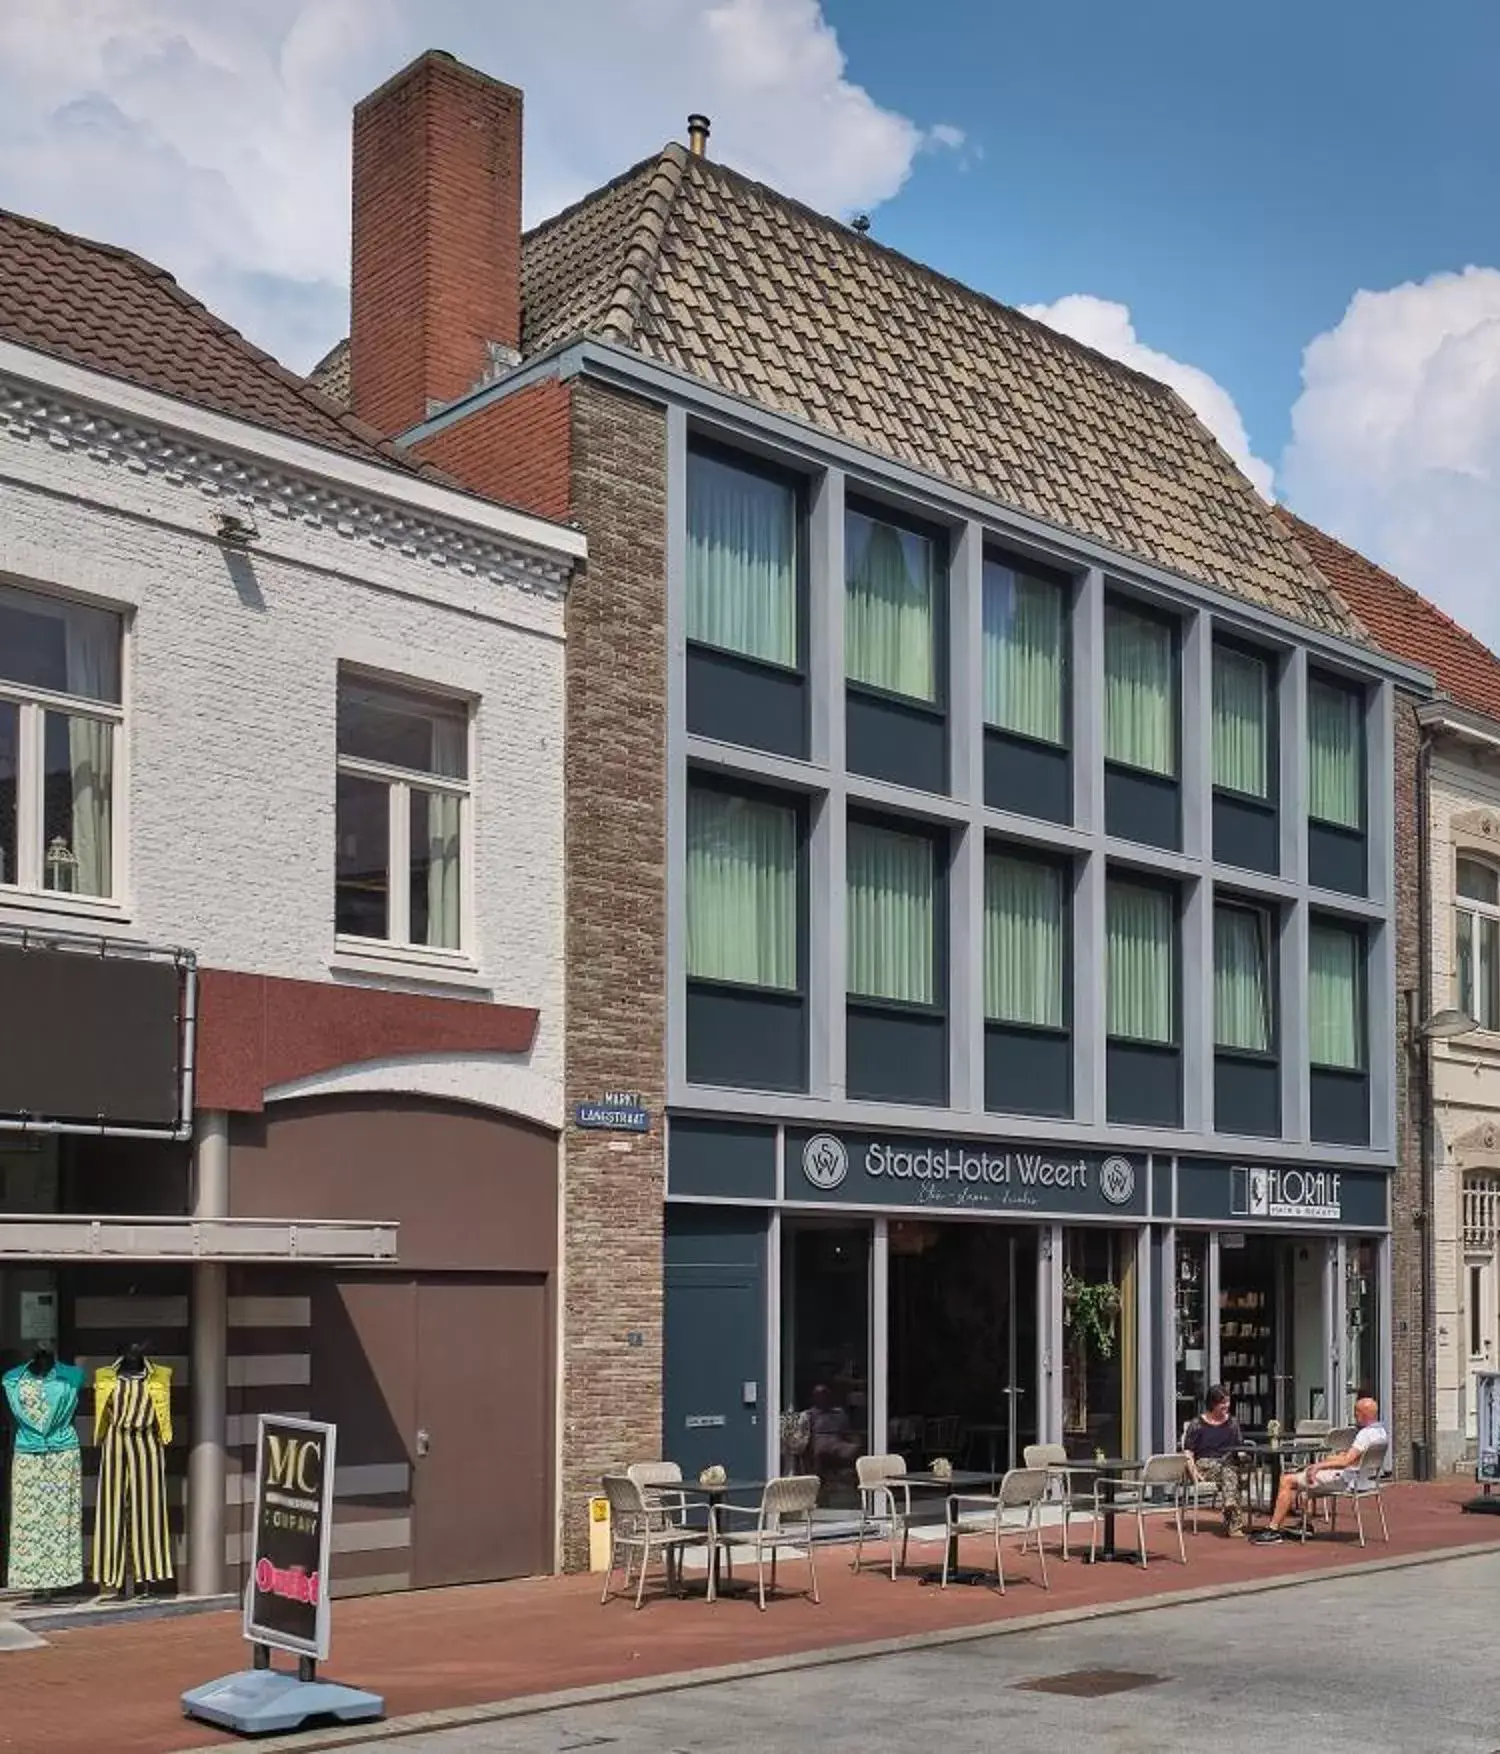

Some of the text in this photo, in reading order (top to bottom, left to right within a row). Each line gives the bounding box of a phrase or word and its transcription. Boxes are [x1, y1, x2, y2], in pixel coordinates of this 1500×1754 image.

[865, 1144, 1087, 1187] StadsHotel Weert
[1268, 1169, 1340, 1206] FLORALE
[266, 1435, 321, 1493] MC
